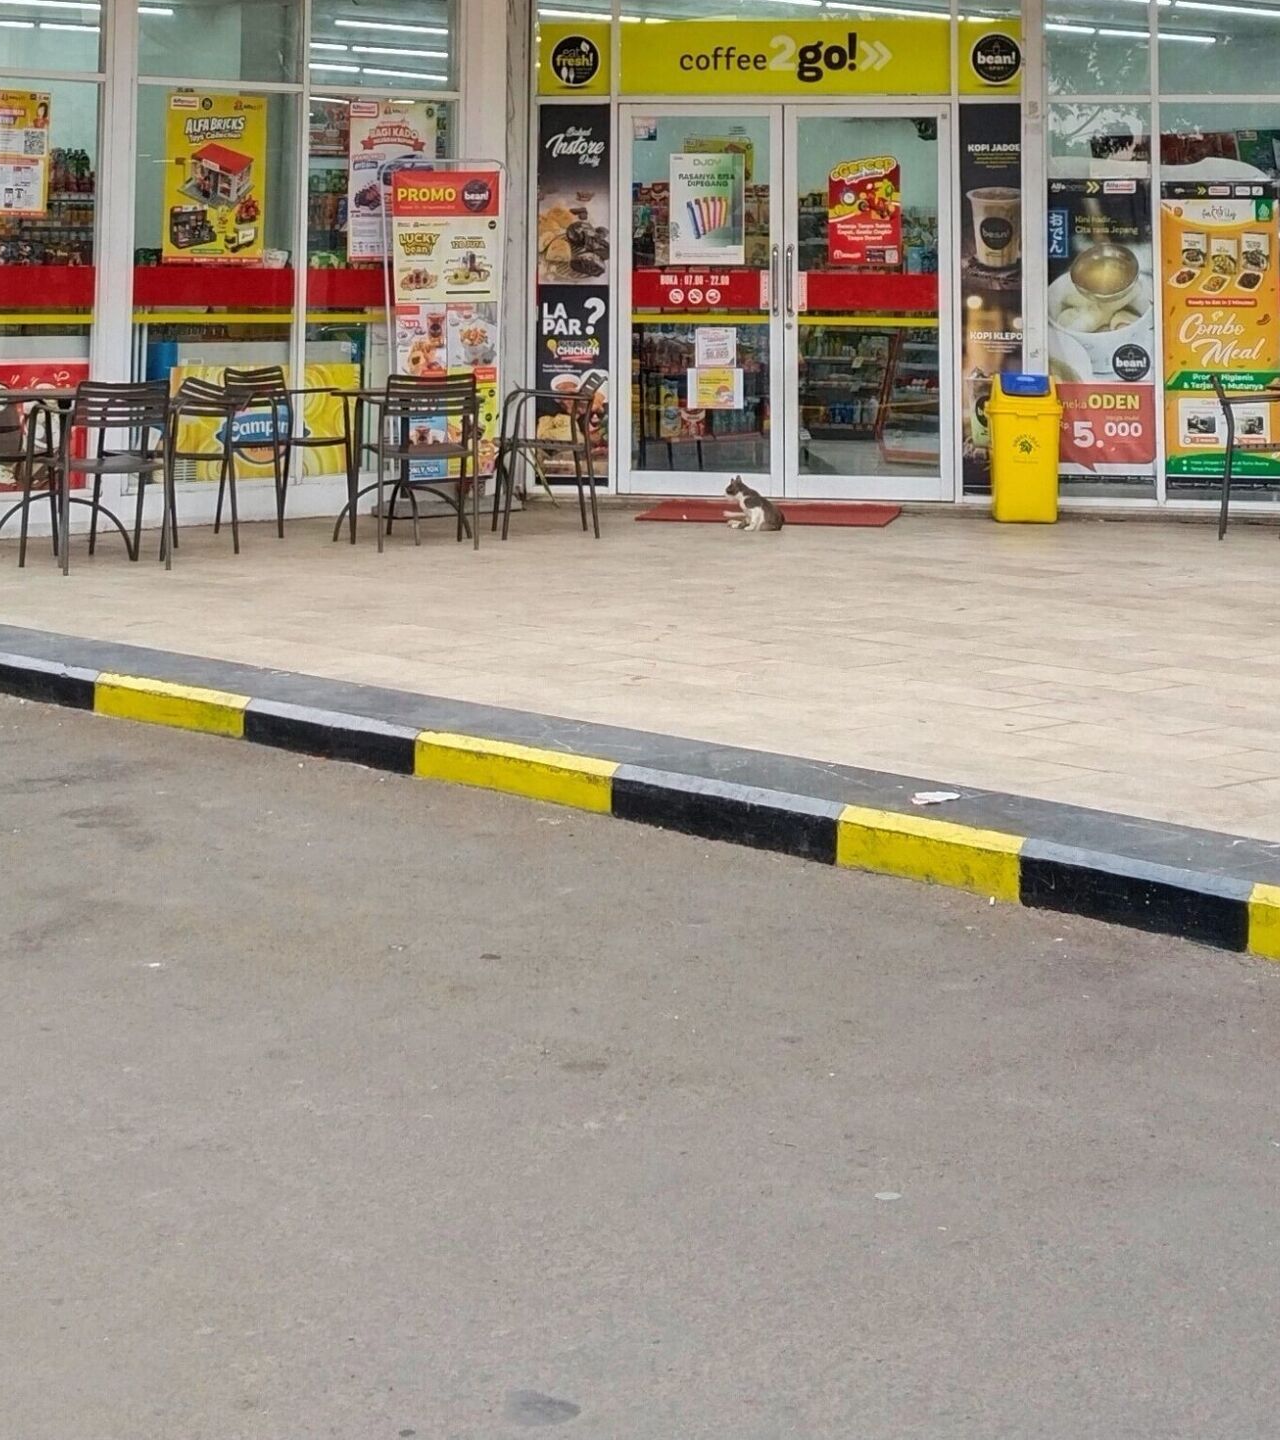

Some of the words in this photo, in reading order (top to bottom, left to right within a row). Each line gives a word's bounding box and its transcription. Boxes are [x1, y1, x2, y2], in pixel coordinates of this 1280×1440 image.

[562, 46, 580, 57] eat
[977, 51, 1016, 65] bean!
[556, 52, 593, 66] fresh!
[185, 118, 210, 135] ALFA
[210, 116, 246, 131] BRICKS
[566, 126, 592, 137] Baked
[545, 133, 605, 158] Instore
[968, 143, 990, 152] KOPI
[992, 143, 1020, 152] JADOE
[578, 154, 601, 168] Daily
[678, 173, 716, 181] RASANYA
[397, 187, 456, 202] PROMO
[464, 190, 490, 201] bean!
[1049, 213, 1064, 254] おでん
[1075, 226, 1091, 234] Cita
[1111, 226, 1139, 236] Jepang
[399, 233, 440, 245] LUCKY
[660, 275, 678, 285] BUKA
[684, 275, 704, 285] 07.00
[710, 275, 730, 285] 22.00
[542, 303, 568, 319] LA
[542, 319, 582, 336] PAR
[1179, 312, 1245, 344] Combo
[970, 331, 992, 340] KOPI
[993, 331, 1022, 340] KLEPO
[557, 346, 600, 356] CHICKEN
[1191, 338, 1266, 368] Meal
[1115, 357, 1147, 368] bean!
[1221, 373, 1254, 382] Higienis
[1190, 382, 1226, 390] Terjan
[1228, 382, 1264, 391] Mutunya
[1088, 394, 1140, 410] ODEN
[231, 420, 289, 442] Campin
